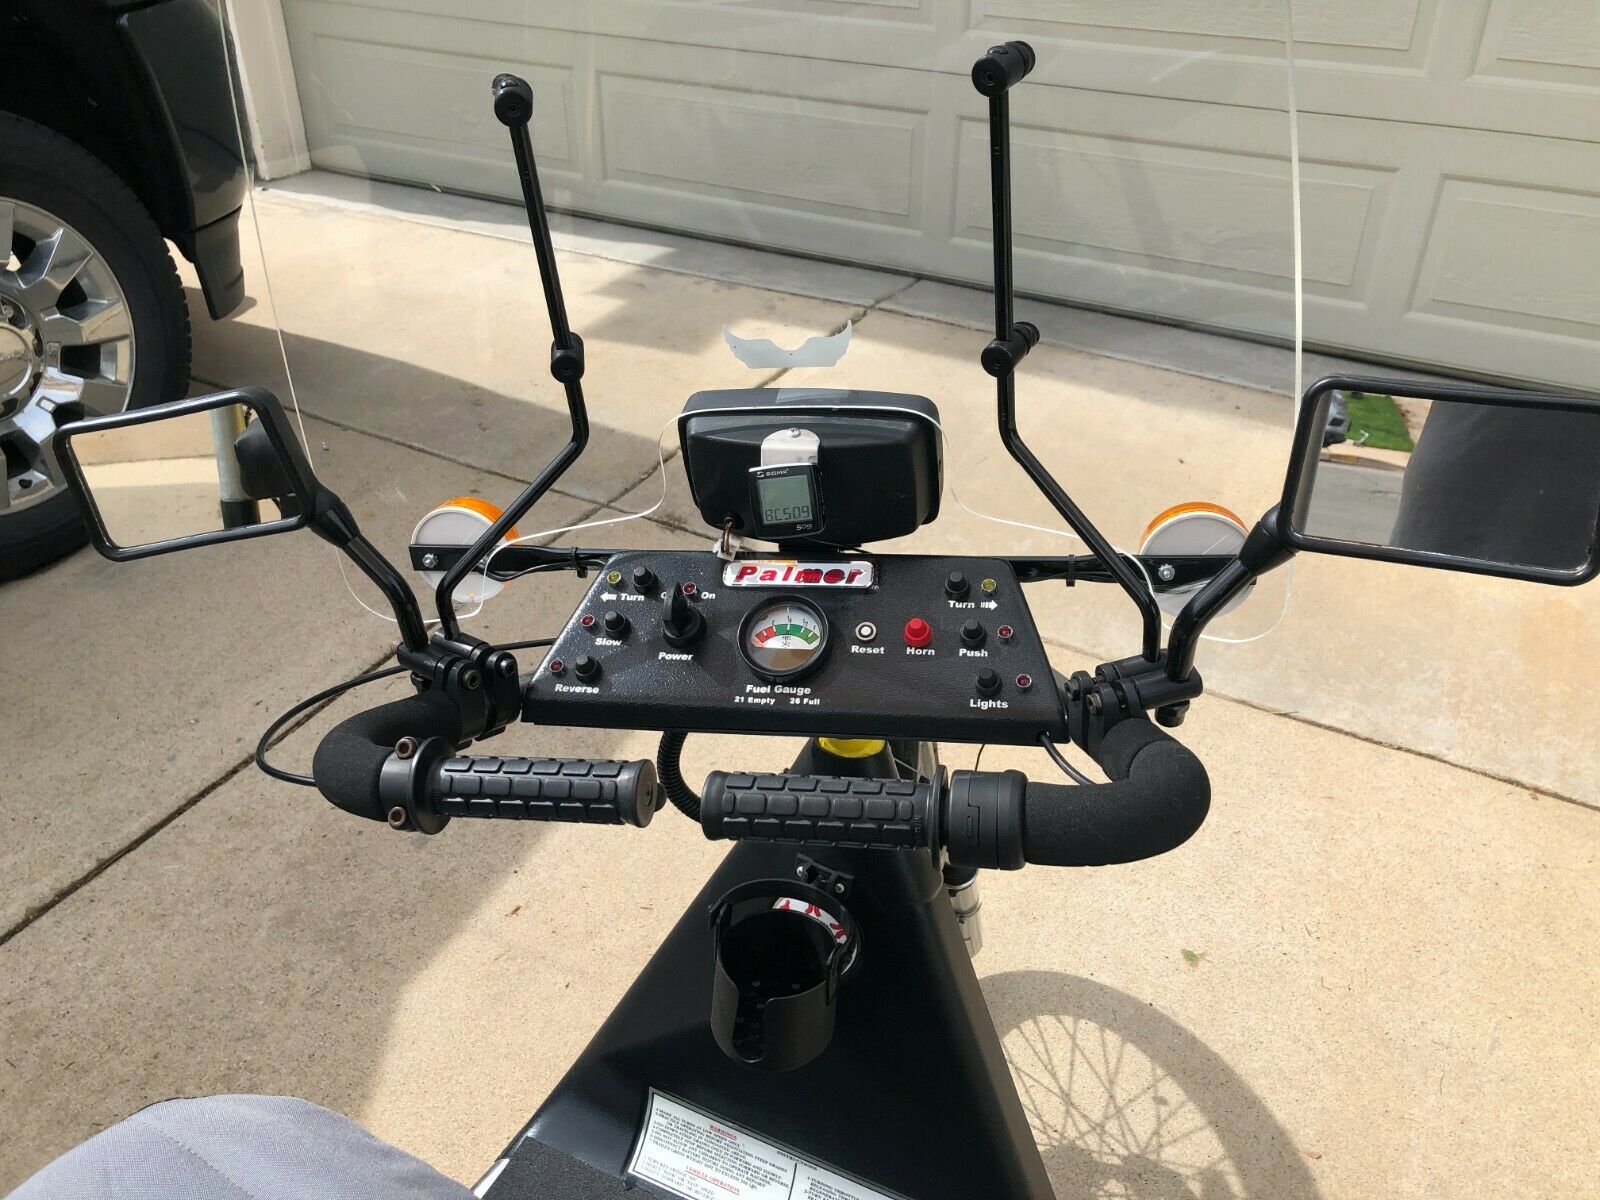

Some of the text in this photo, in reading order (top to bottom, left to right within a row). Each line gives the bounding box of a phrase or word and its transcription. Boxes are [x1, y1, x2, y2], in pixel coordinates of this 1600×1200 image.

[734, 564, 864, 584] Palmer
[620, 593, 644, 602] Turn
[701, 592, 716, 600] On
[948, 600, 975, 608] Turn
[595, 638, 621, 646] Slow
[852, 645, 884, 654] Reset
[906, 648, 935, 656] Horn
[959, 648, 988, 657] Push
[658, 652, 692, 662] Power
[555, 684, 600, 694] Reverse
[746, 685, 811, 696] Fuel Gauge
[748, 697, 775, 705] Empty
[970, 700, 1008, 710] Lights
